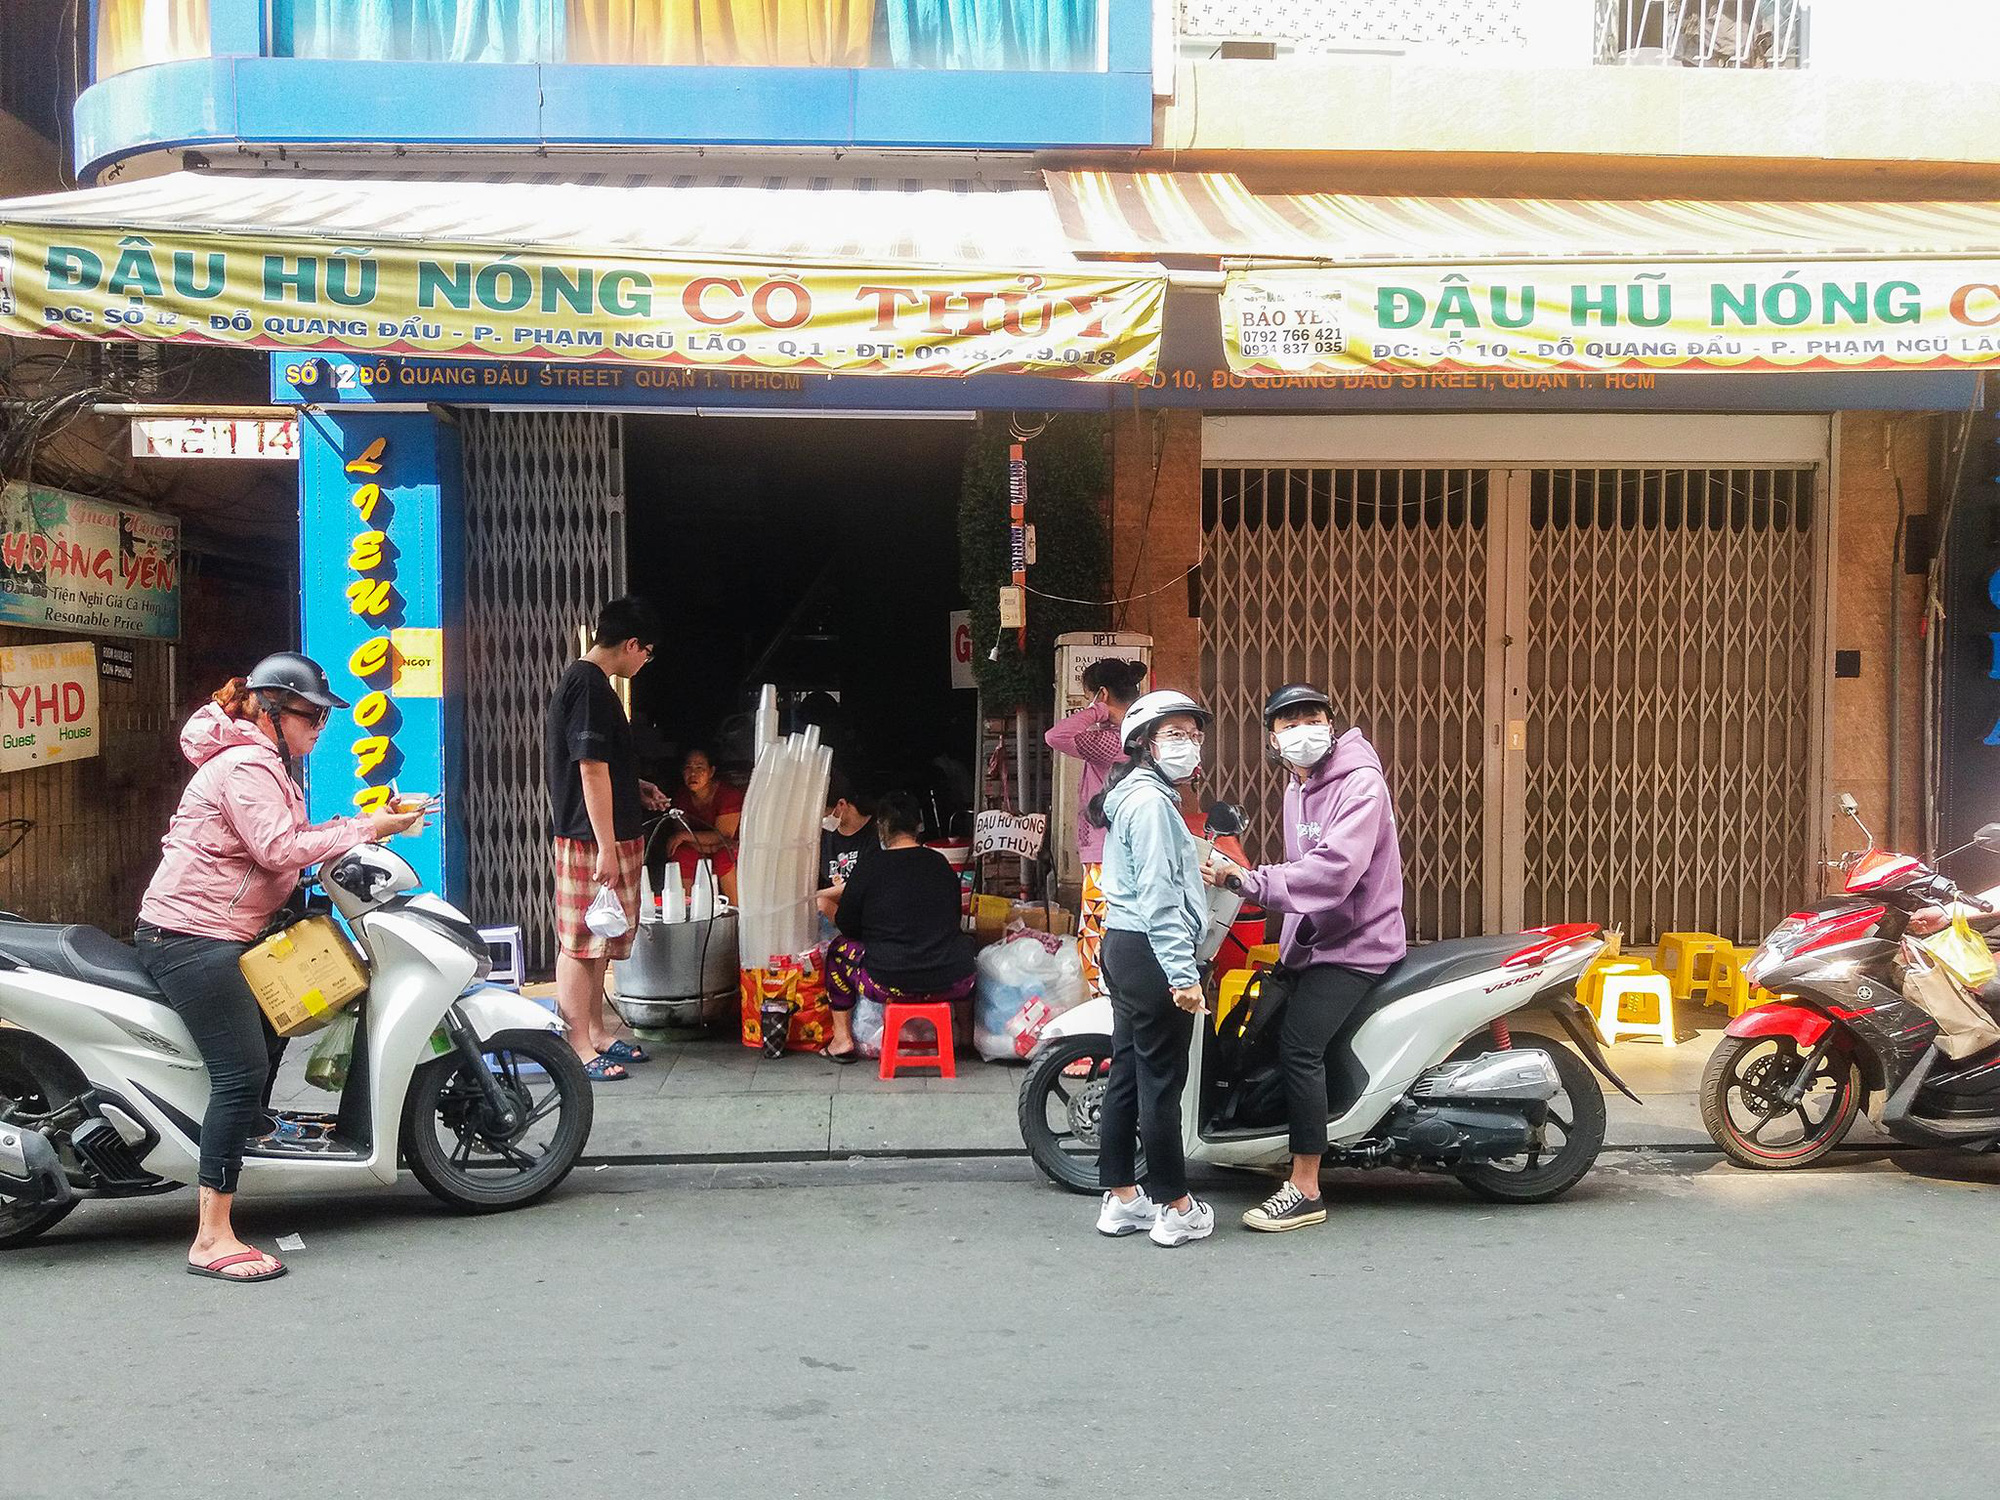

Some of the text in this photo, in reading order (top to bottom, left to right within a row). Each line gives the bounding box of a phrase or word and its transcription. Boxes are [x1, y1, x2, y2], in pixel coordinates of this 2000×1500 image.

[44, 235, 227, 306] ĐẬU
[263, 247, 377, 307] HŨ
[418, 253, 653, 317] NÓNG
[1242, 305, 1286, 326] BẢO
[1374, 273, 1535, 338] ĐẬU
[1571, 272, 1671, 327] HŨ
[1710, 270, 1921, 326] NÓNG
[44, 307, 93, 323] ĐC:
[156, 312, 179, 325] 12
[210, 309, 252, 331] ĐỖ
[264, 317, 368, 337] QUANG
[474, 326, 502, 342] P.
[514, 328, 603, 347] PHẠM
[614, 331, 674, 349] NGŨ
[688, 333, 747, 352] LÃO
[777, 340, 824, 358] Q.1
[855, 343, 904, 360] ĐT:
[1243, 328, 1342, 342] 0792 766 421
[1244, 342, 1342, 355] 0934 837 035
[1373, 344, 1418, 358] ĐC:
[1476, 344, 1508, 357] 10
[1538, 336, 1574, 357] ĐỖ
[1585, 342, 1677, 358] QUANG
[1771, 341, 1796, 354] P.
[1807, 340, 1884, 356] PHẠM
[1896, 336, 1949, 352] NGŨ
[286, 357, 318, 385] SỐ
[329, 363, 357, 389] 12
[360, 358, 391, 384] ĐỖ
[400, 367, 476, 386] QUANG
[540, 368, 623, 387] STREET
[727, 372, 801, 390] TPHCM
[1172, 370, 1201, 391] 10,
[1605, 373, 1656, 389] HCM
[2, 531, 113, 587] HOÀNG
[79, 590, 103, 609] Nghi
[106, 594, 123, 609] Giá
[44, 607, 144, 632] Resonable Price
[8, 681, 85, 730] YHD
[2, 726, 92, 749] Guest House
[349, 636, 391, 843] COFF
[1483, 970, 1544, 994] VISION
